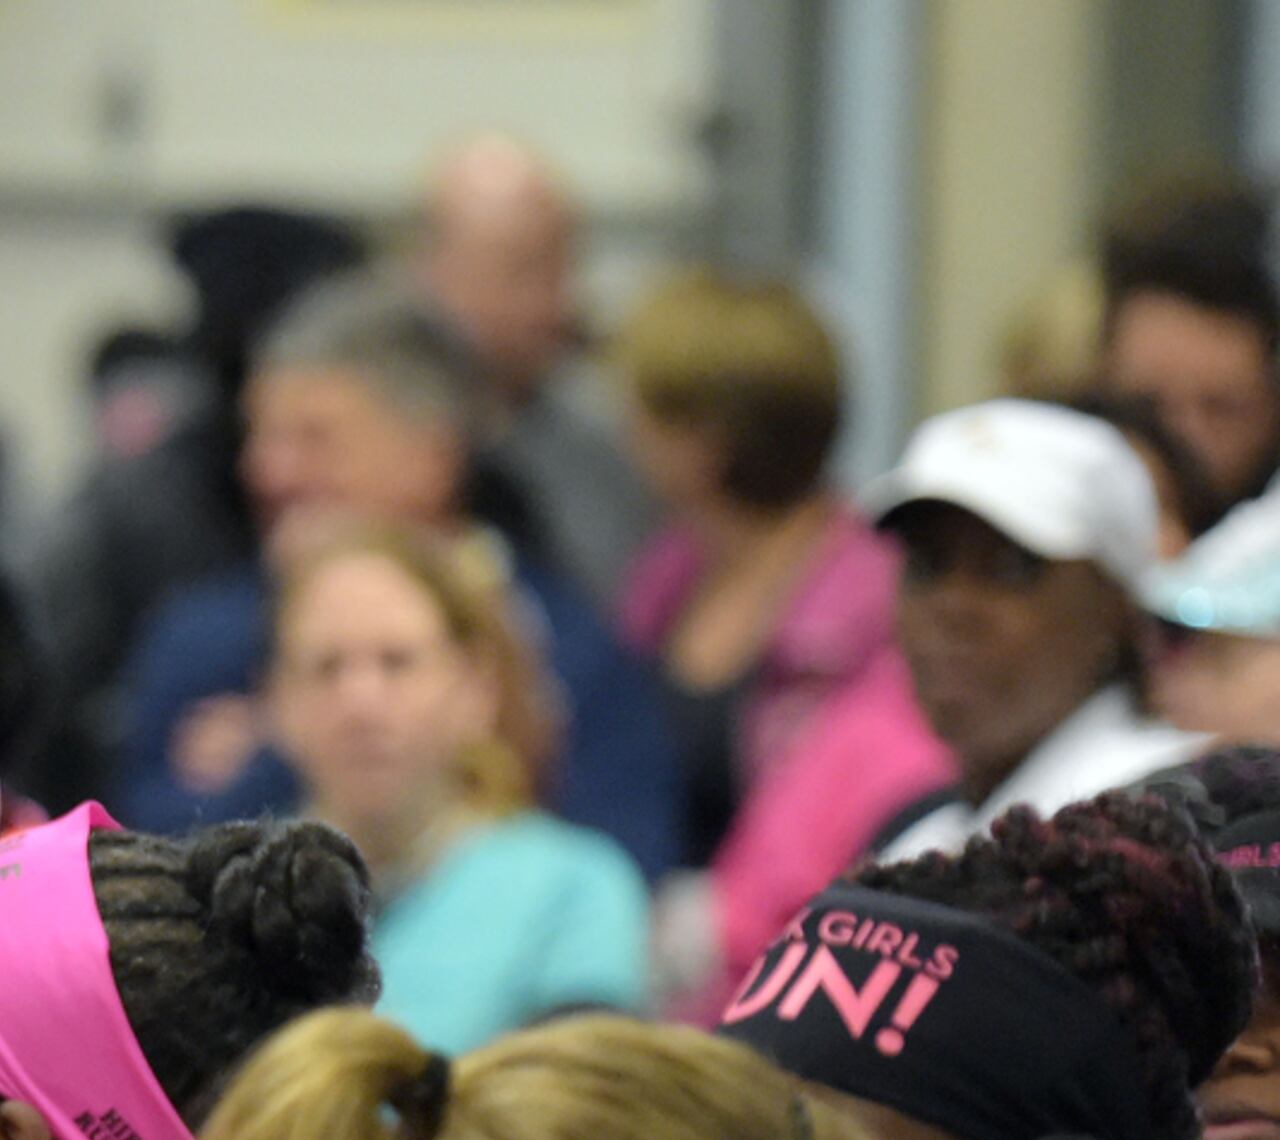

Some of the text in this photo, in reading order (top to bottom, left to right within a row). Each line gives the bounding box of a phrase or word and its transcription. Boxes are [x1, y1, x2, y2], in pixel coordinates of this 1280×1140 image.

[1216, 842, 1280, 869] IRLS
[818, 910, 960, 980] GIRLS
[721, 943, 940, 1056] UN!
